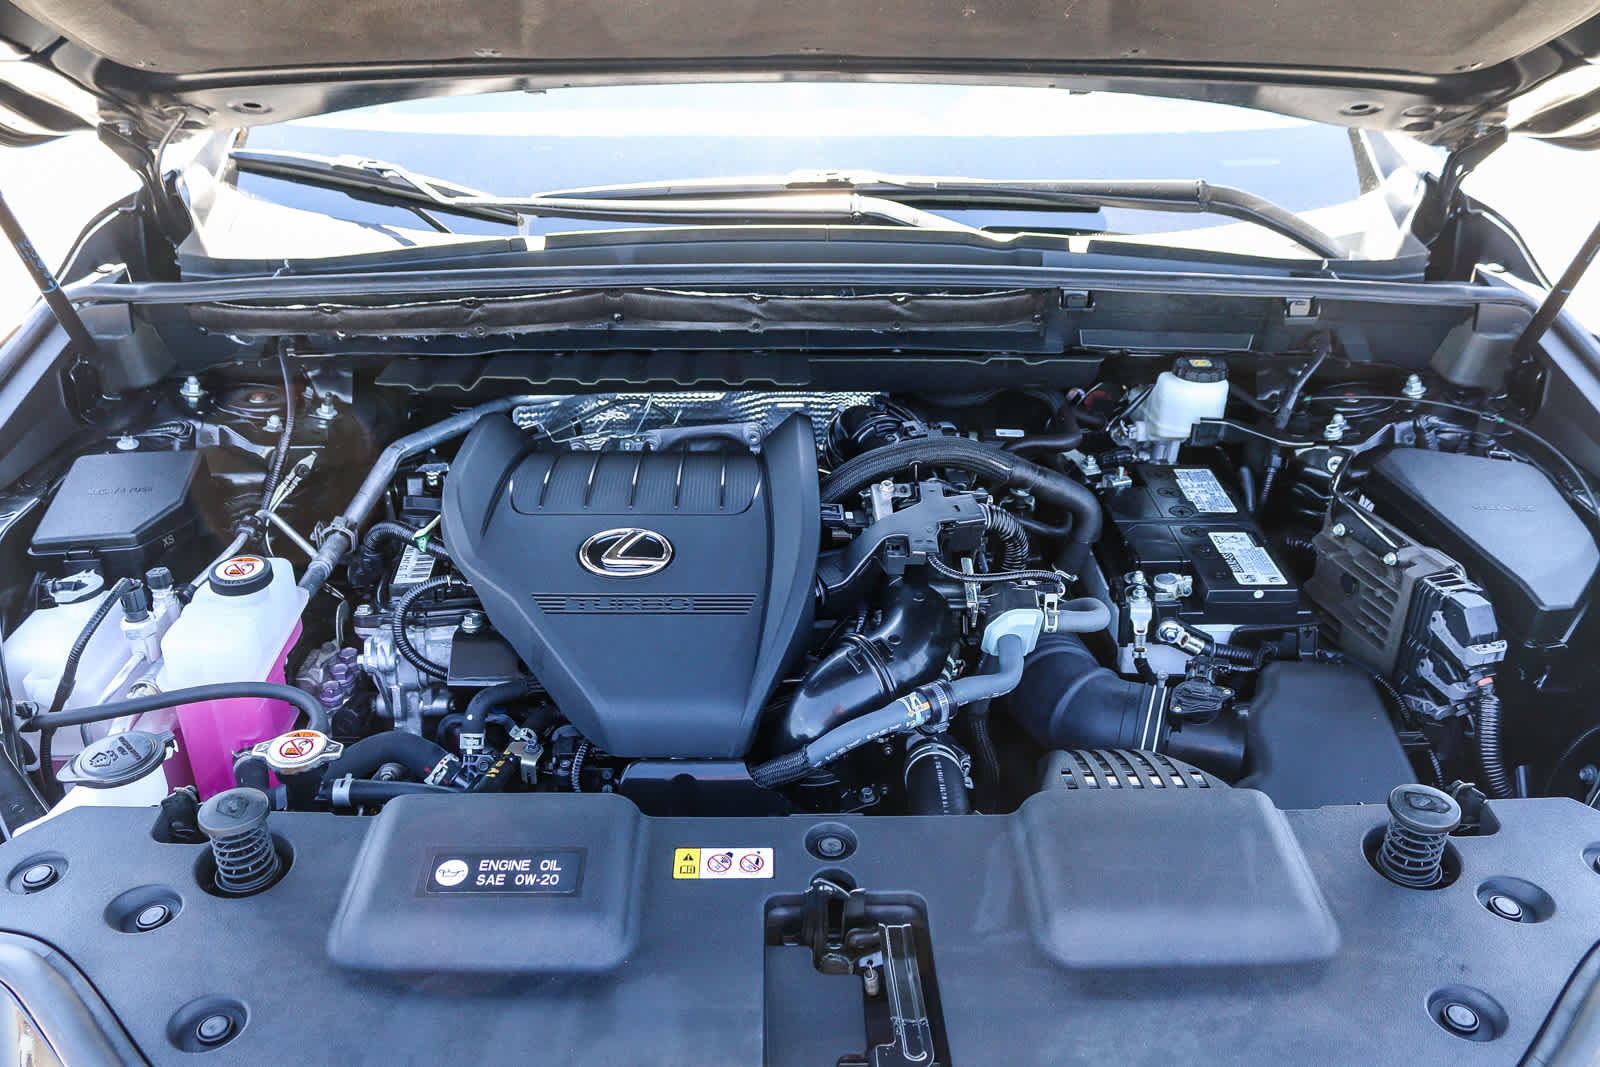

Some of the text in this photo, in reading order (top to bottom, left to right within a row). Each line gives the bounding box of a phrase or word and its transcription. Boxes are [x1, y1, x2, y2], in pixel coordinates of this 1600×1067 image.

[568, 597, 690, 611] TURBO
[478, 859, 562, 872] ENGINE OIL
[475, 873, 506, 886] SAE
